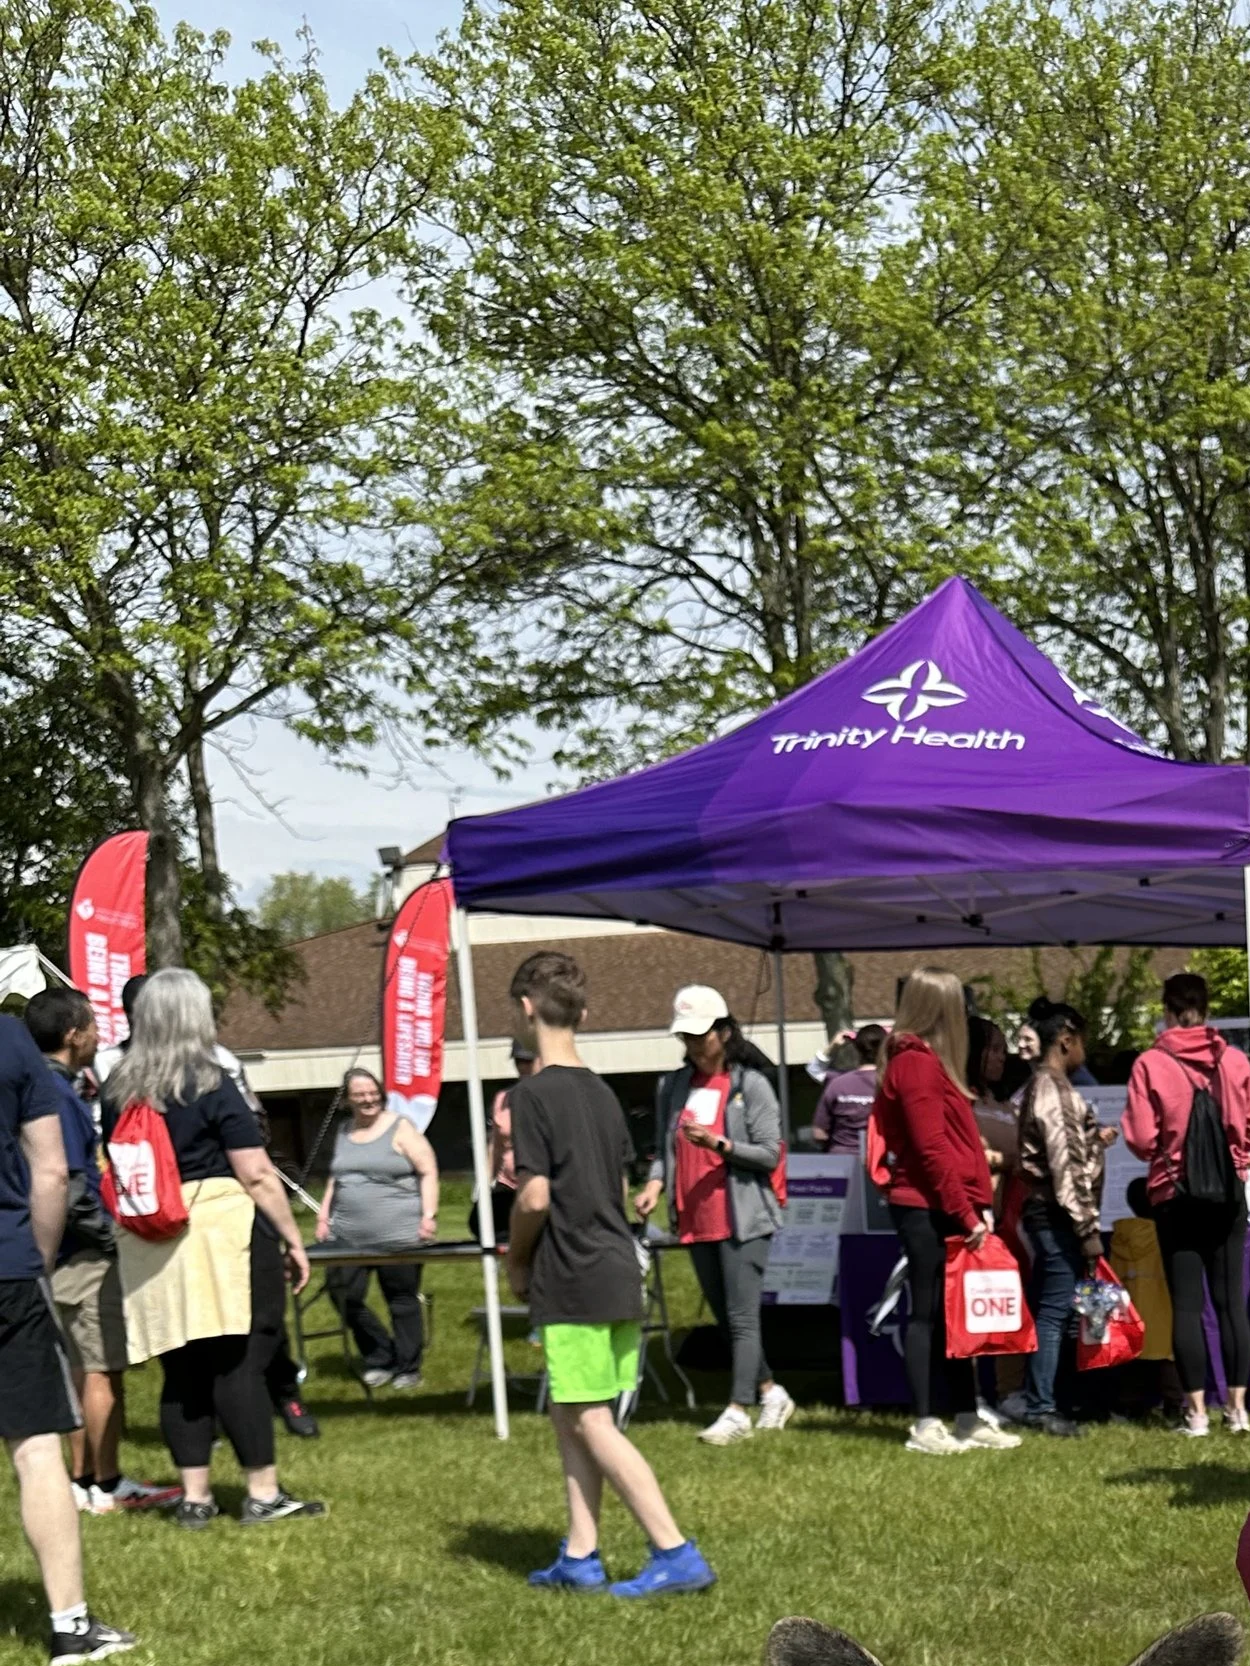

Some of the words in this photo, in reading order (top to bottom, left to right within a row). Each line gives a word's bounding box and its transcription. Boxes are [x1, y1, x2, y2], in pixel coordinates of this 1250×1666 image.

[771, 726, 888, 754] Trinity
[891, 723, 1026, 751] Health
[85, 932, 109, 986] BEING
[87, 986, 110, 1002] A
[971, 1297, 1016, 1317] ONE
